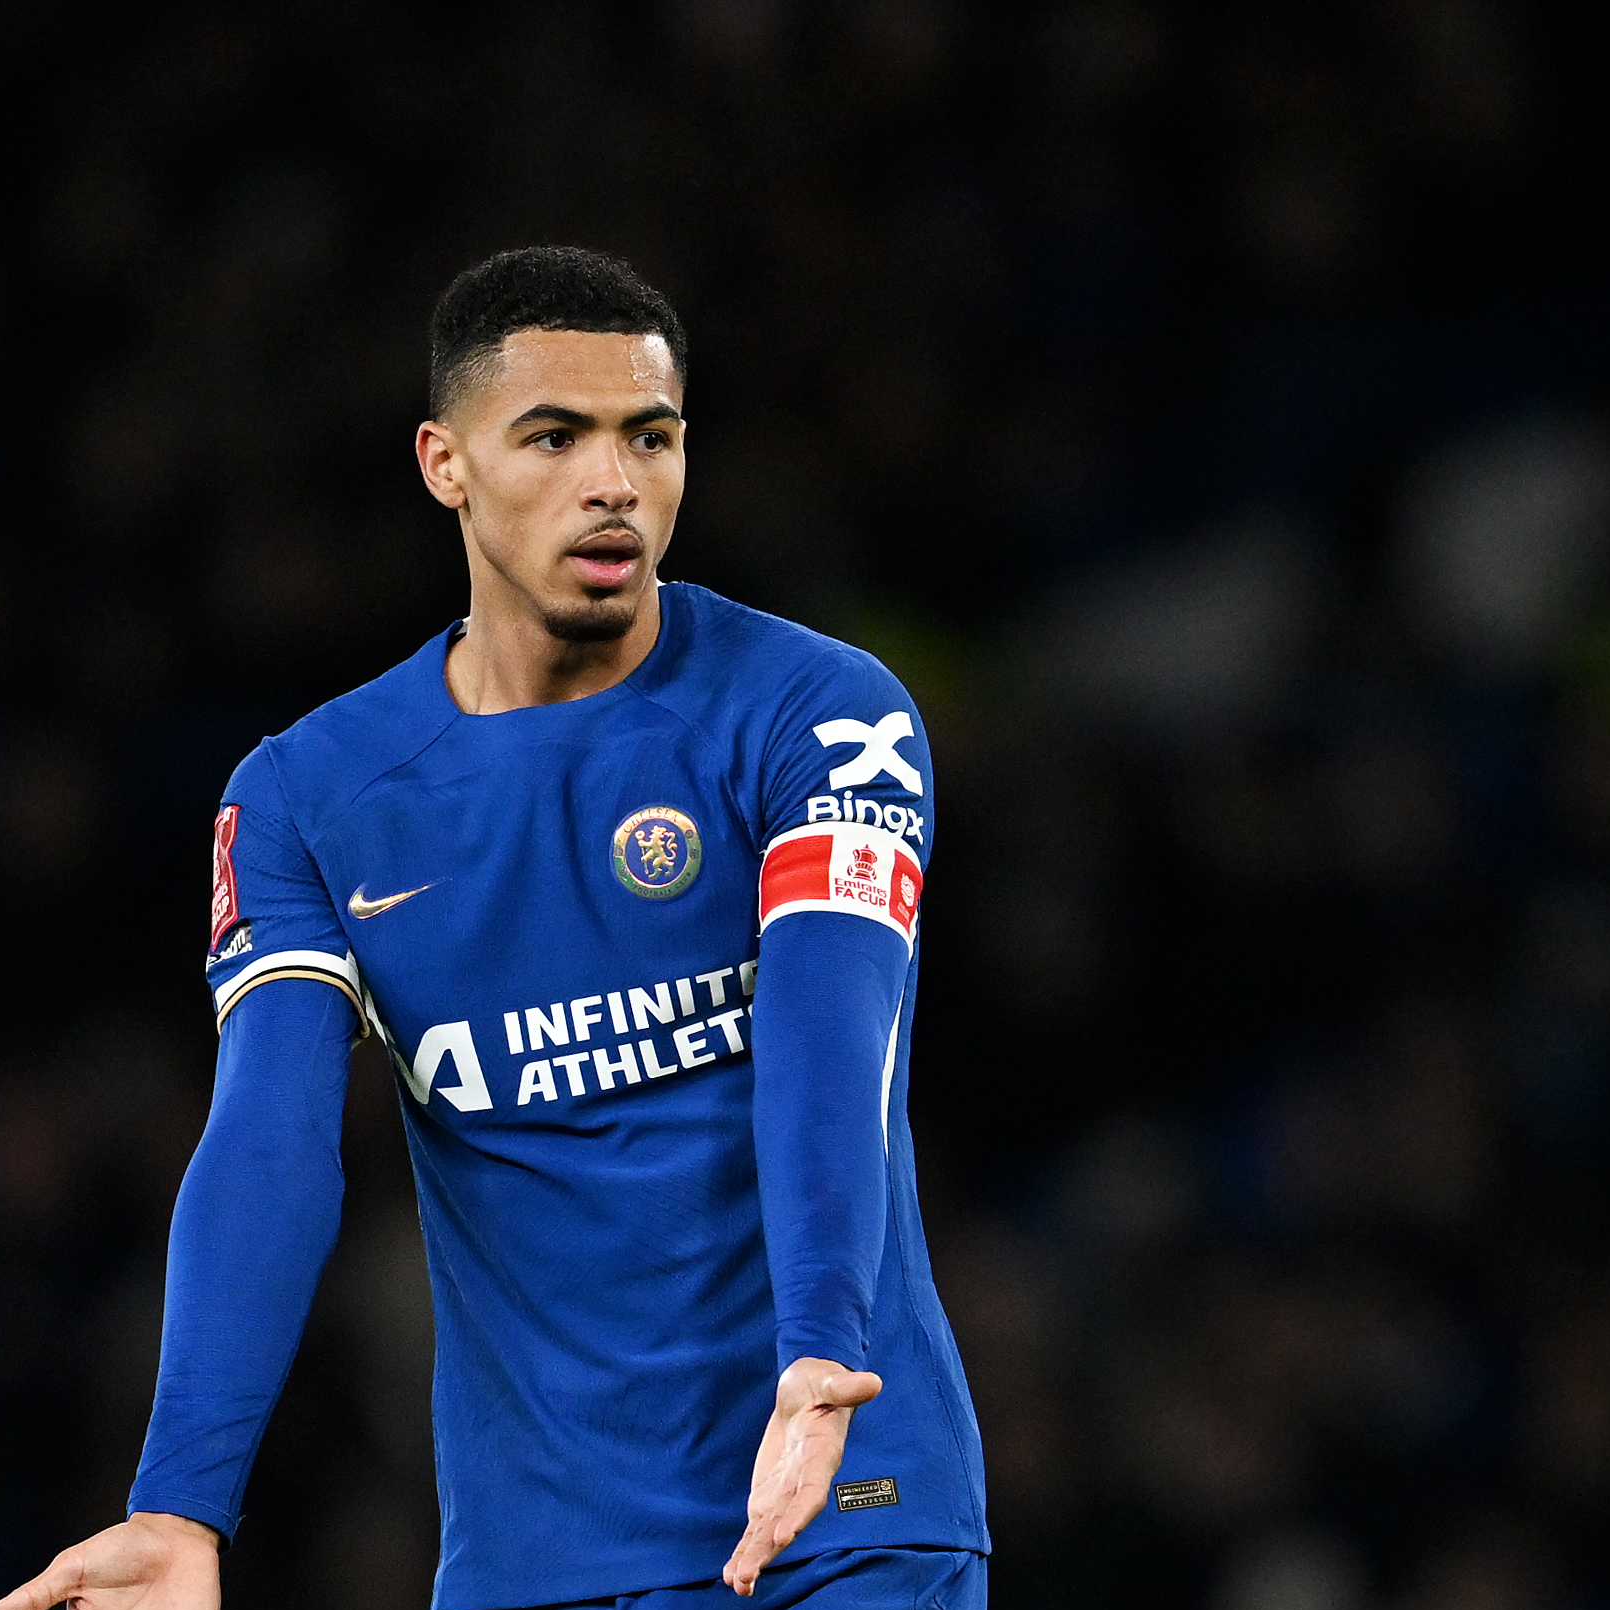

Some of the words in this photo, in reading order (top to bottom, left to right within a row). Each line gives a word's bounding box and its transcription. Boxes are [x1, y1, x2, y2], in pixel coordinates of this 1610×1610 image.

[623, 807, 678, 833] CHELSEA
[834, 877, 888, 899] Emirates
[835, 886, 855, 900] FA
[857, 890, 887, 908] CUP
